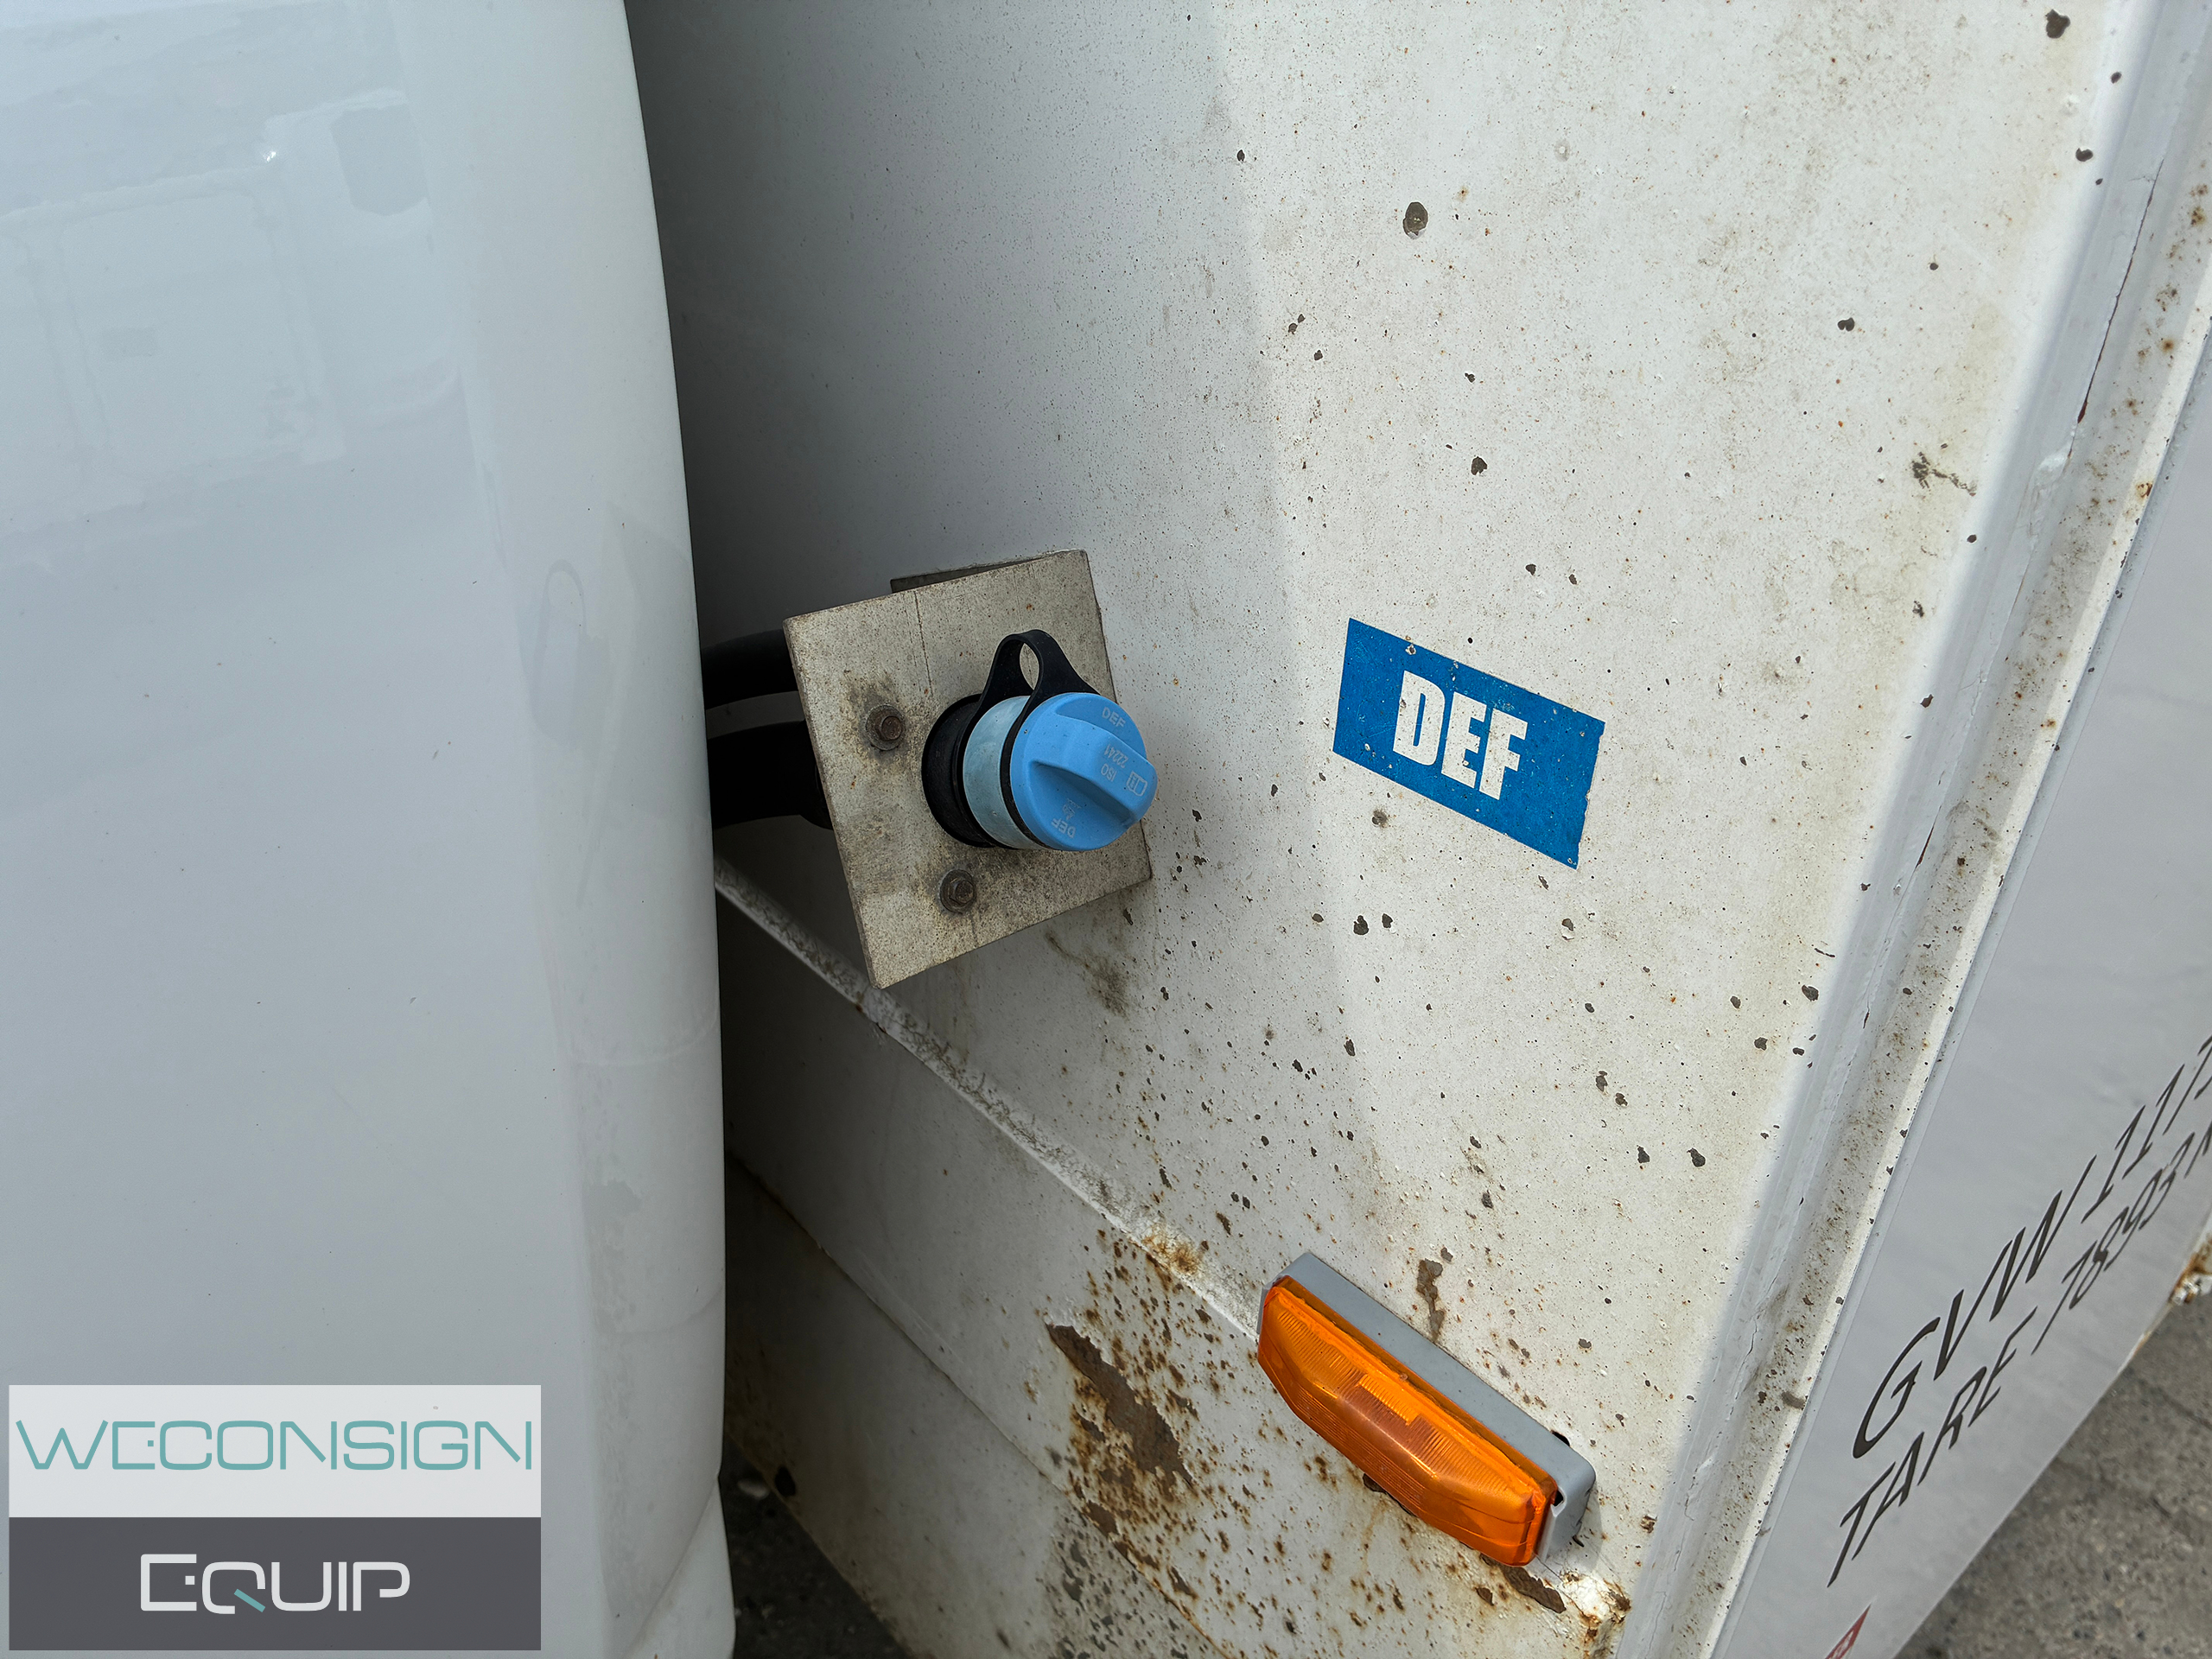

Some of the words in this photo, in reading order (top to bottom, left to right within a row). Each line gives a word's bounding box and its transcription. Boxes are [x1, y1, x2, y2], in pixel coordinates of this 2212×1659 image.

[1102, 706, 1127, 728] DEF
[1393, 670, 1528, 800] DEF
[1105, 744, 1128, 768] 22241
[1101, 763, 1118, 782] ISO
[1051, 817, 1077, 838] DEF
[1853, 1154, 2097, 1459] GVW
[2081, 1034, 2212, 1224] 117
[1827, 1306, 2037, 1587] TARE
[2031, 1131, 2196, 1356] 7893
